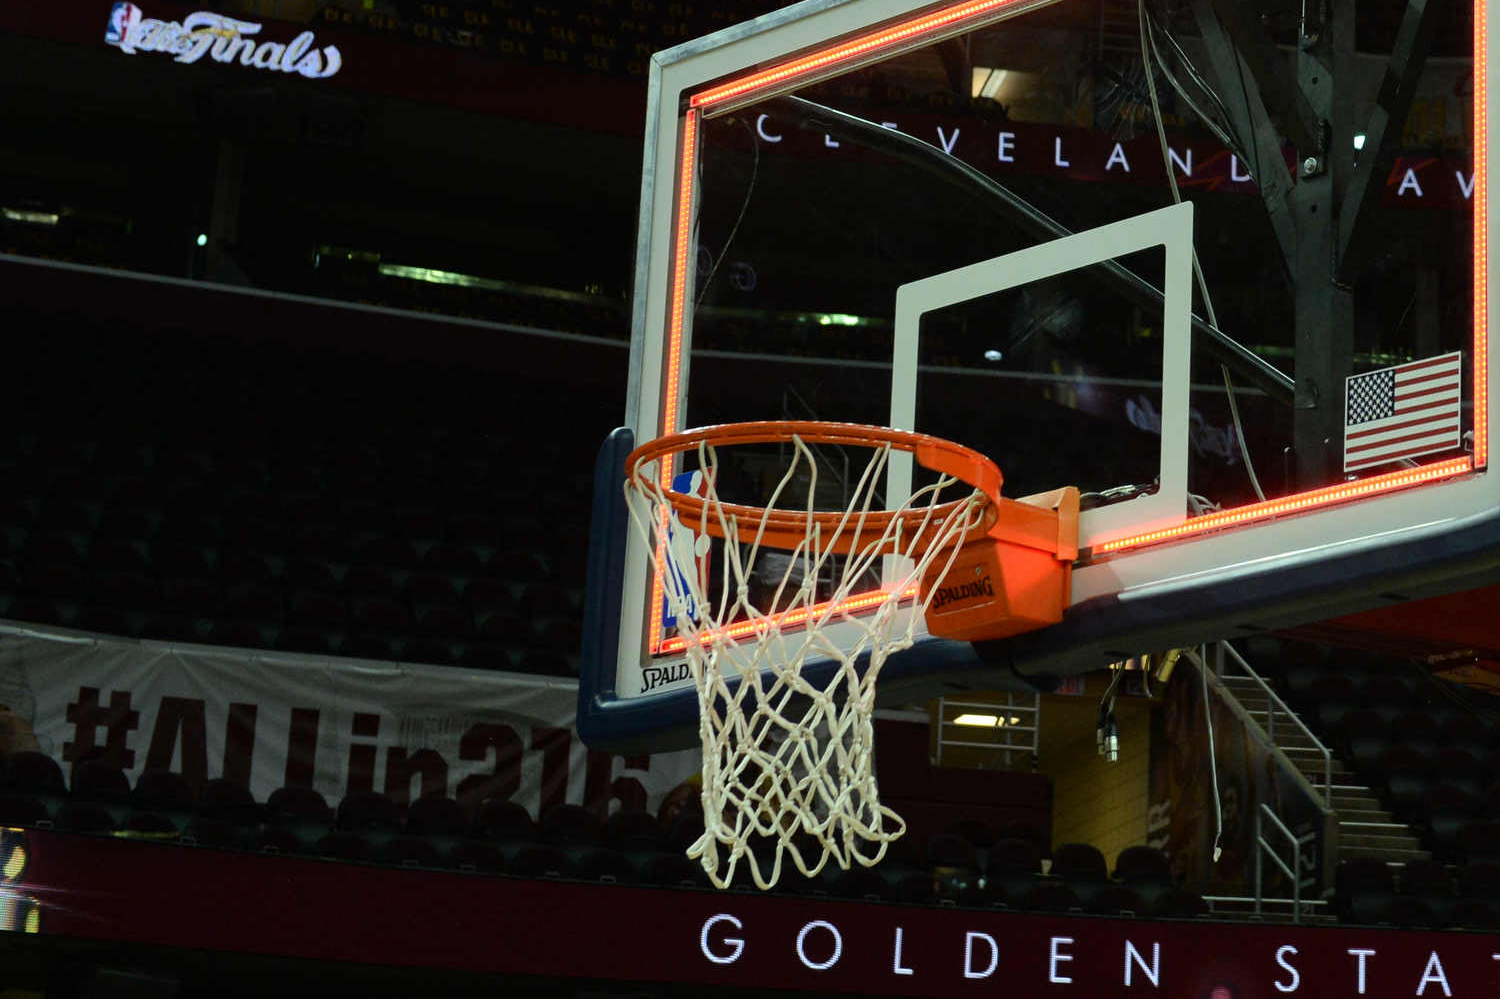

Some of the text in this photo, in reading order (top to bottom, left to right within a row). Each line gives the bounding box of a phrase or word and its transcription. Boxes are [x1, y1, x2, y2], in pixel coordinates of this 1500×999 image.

[172, 10, 343, 79] Finals
[933, 576, 995, 609] SPALDING
[700, 913, 1162, 988] GOLDEN
